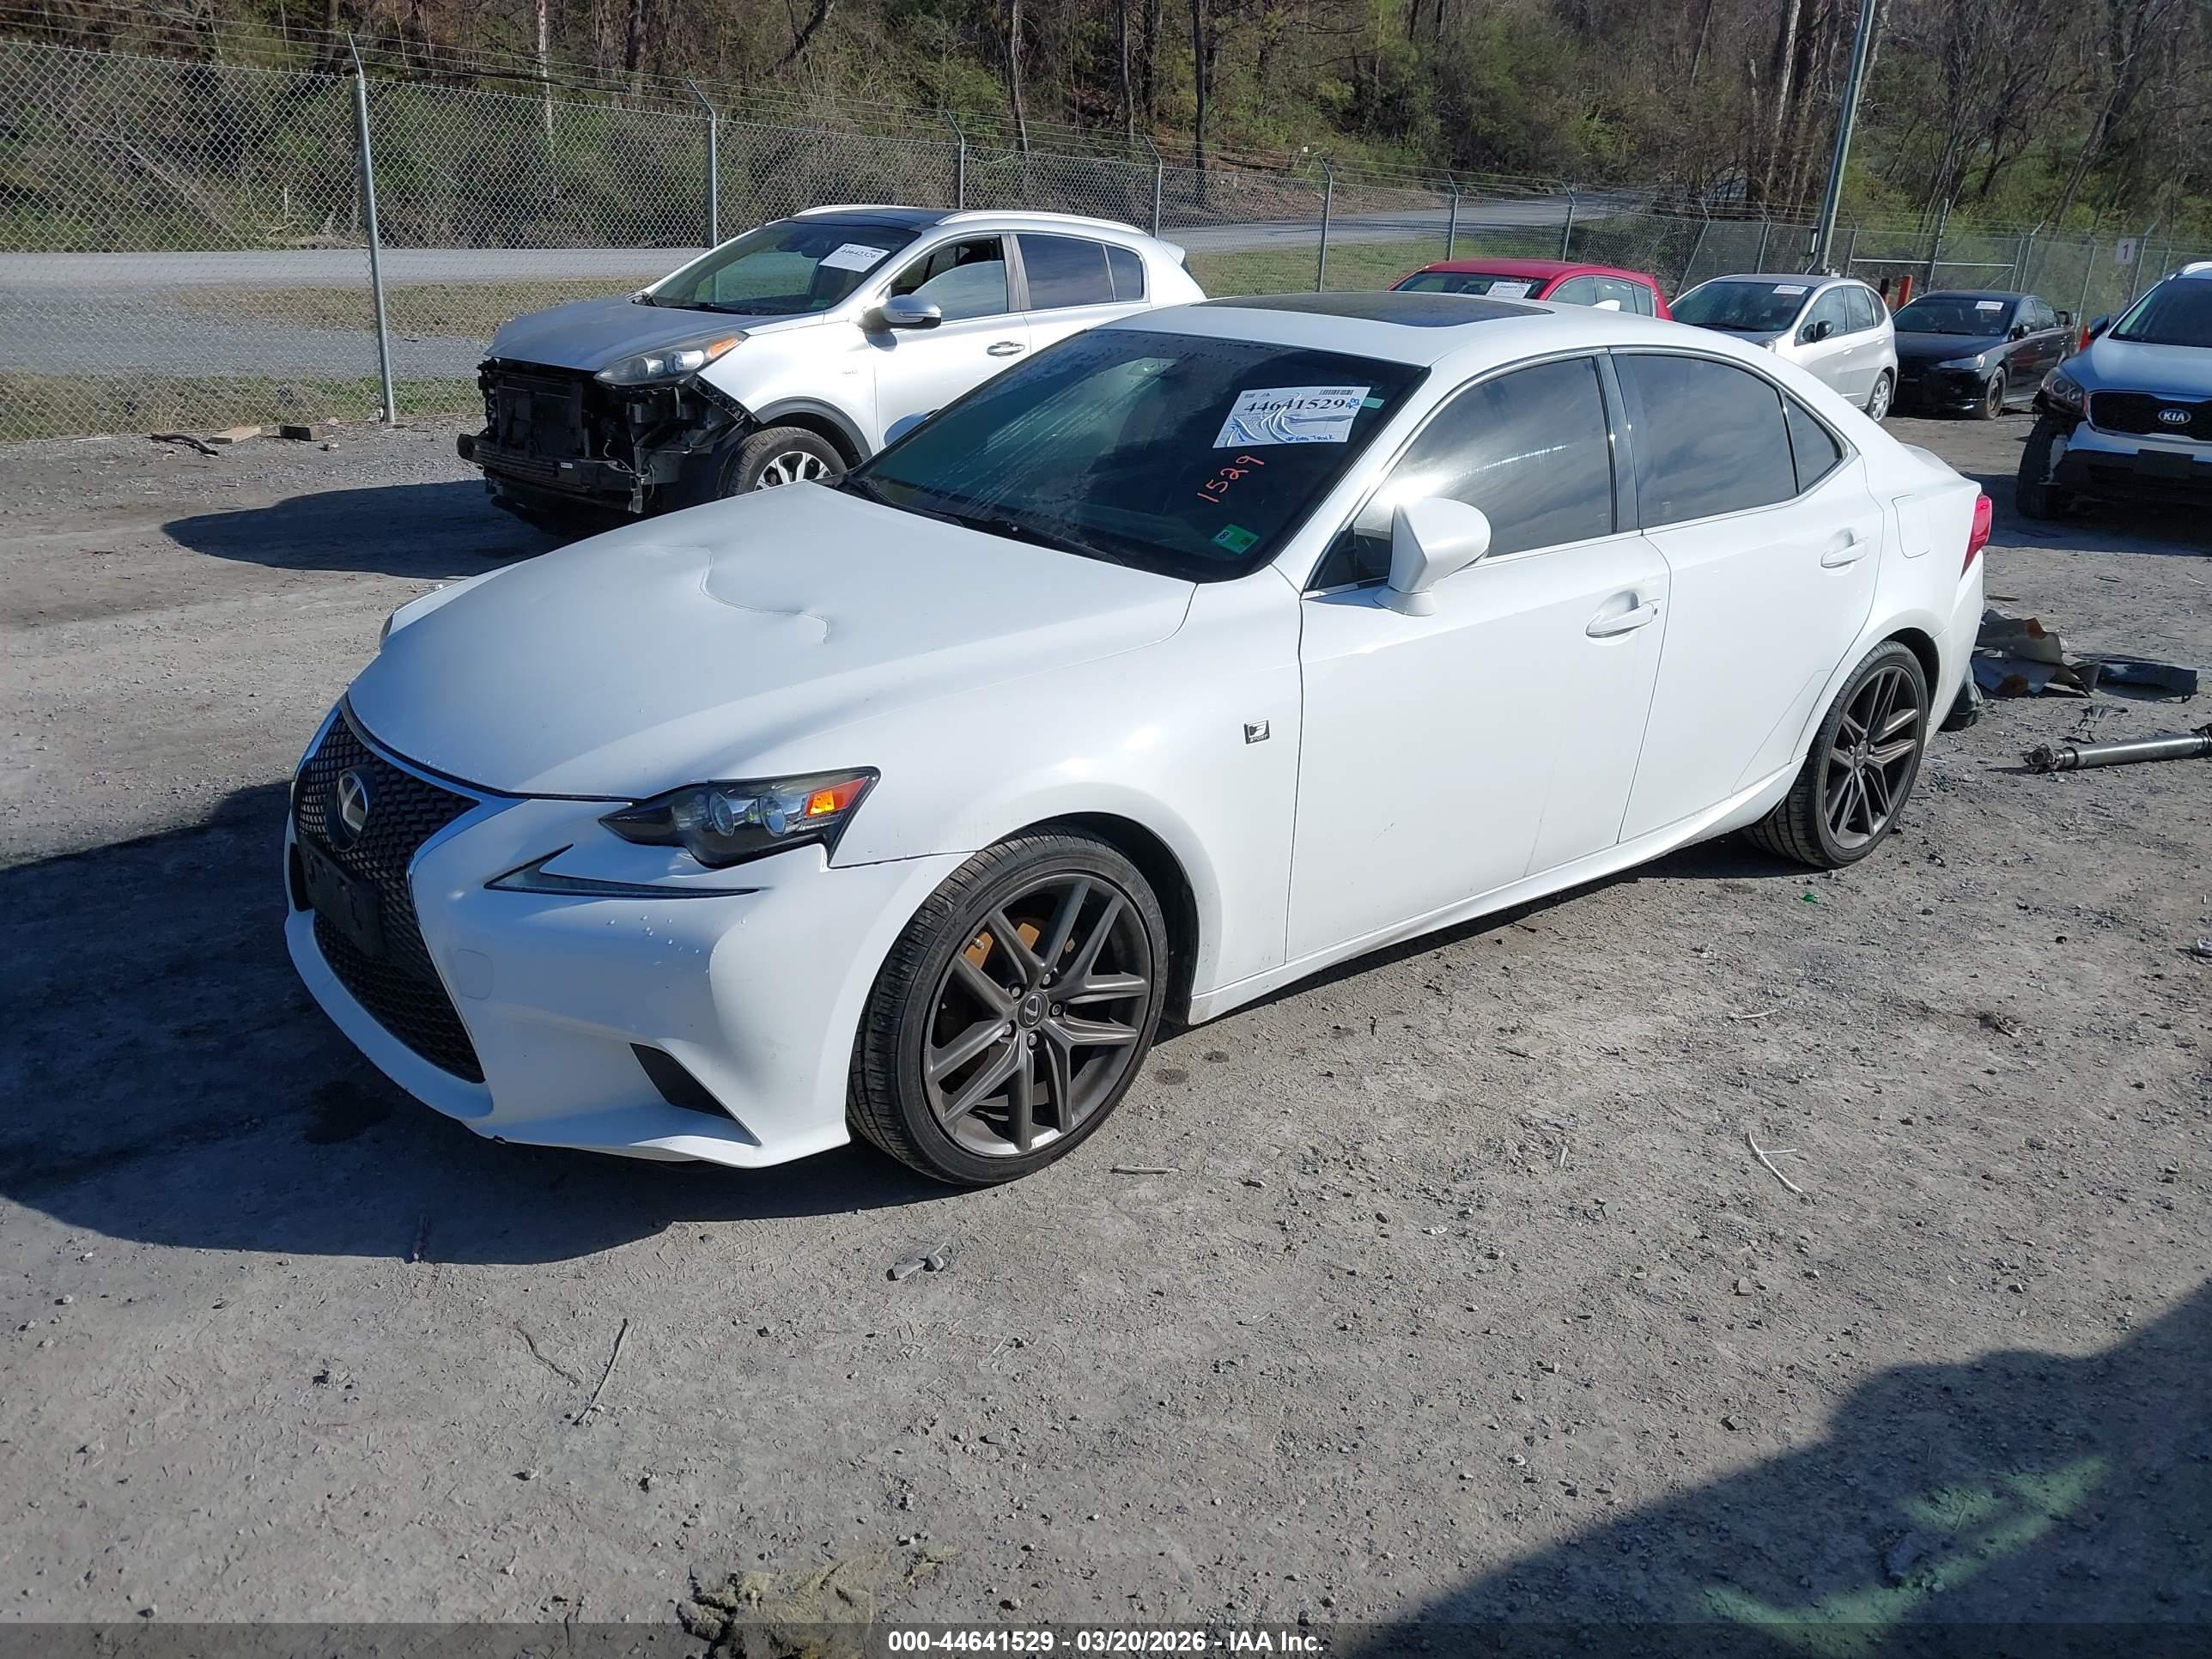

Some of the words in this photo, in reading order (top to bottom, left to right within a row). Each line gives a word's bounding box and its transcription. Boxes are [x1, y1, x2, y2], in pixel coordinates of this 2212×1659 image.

[2122, 243, 2130, 259] 1
[1243, 398, 1346, 412] 44641529
[2163, 411, 2185, 422] KIA
[1196, 455, 1265, 503] 1529
